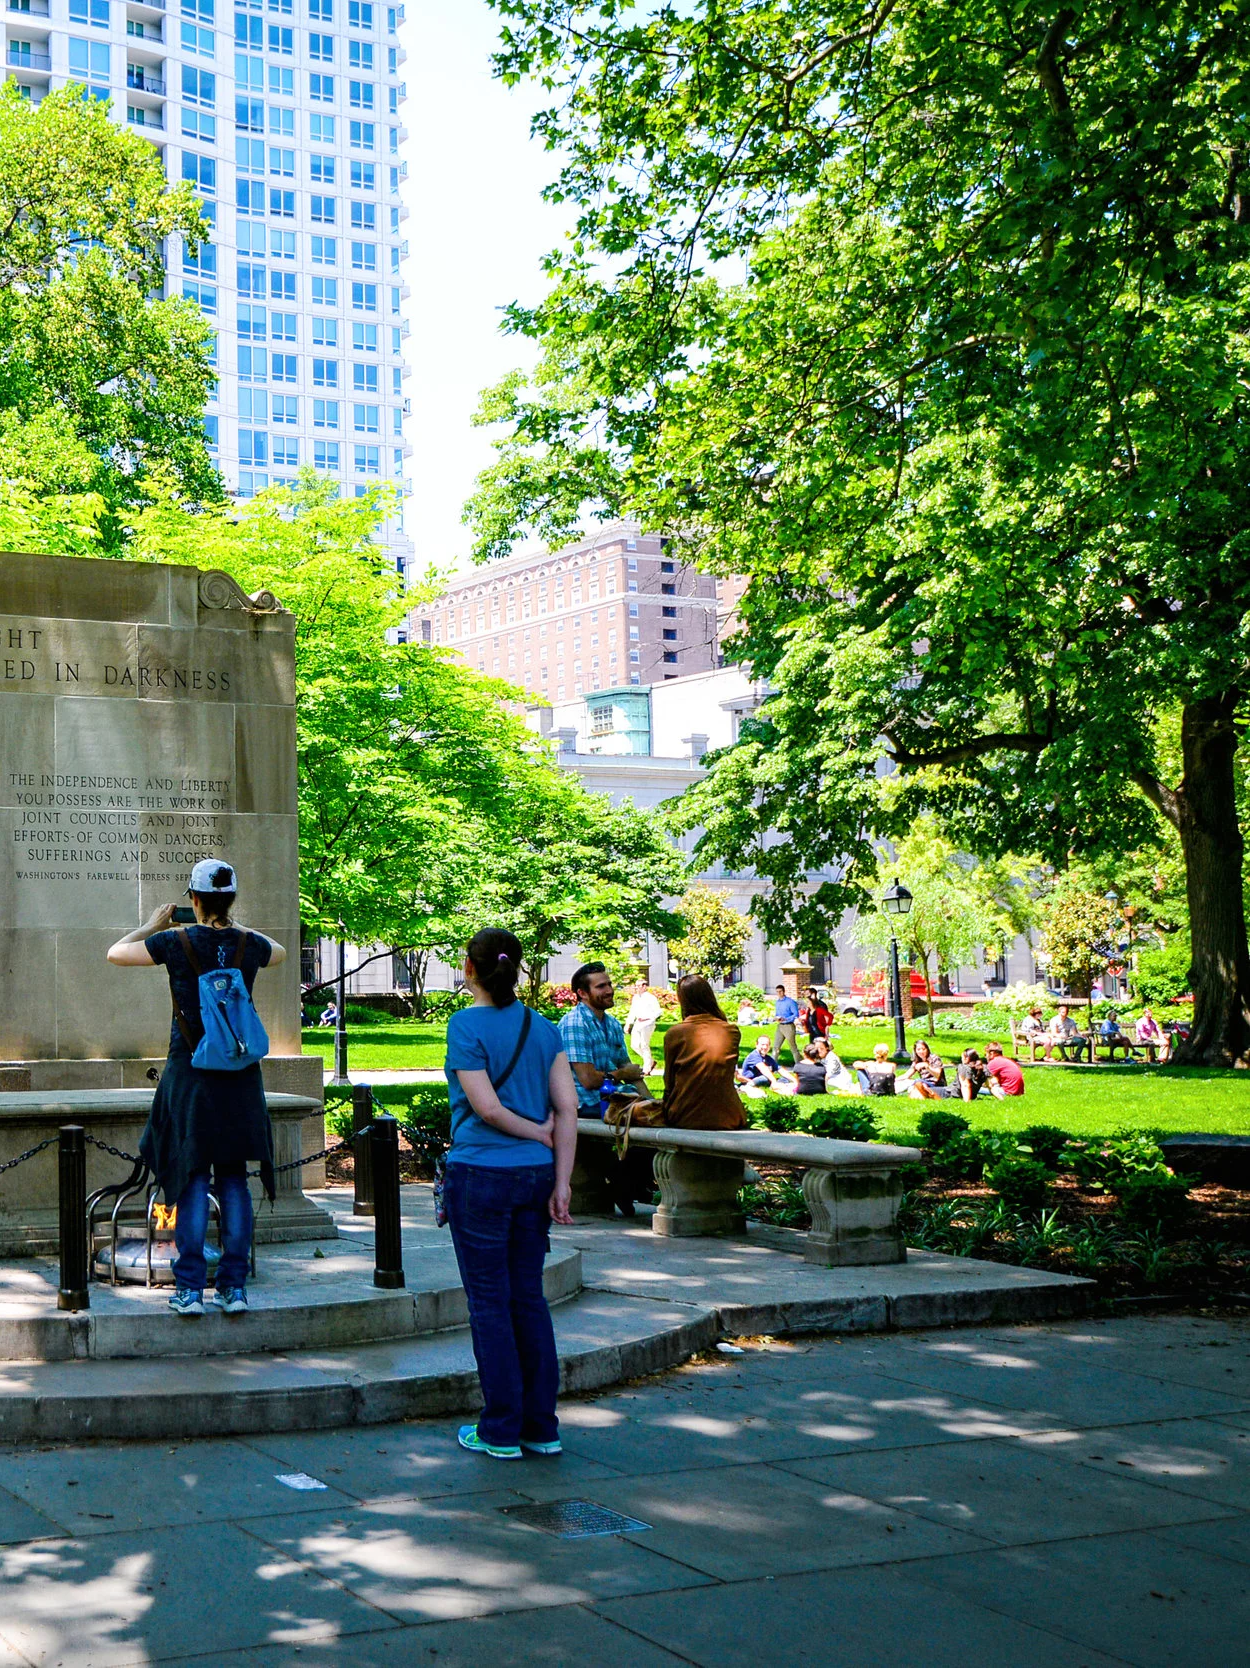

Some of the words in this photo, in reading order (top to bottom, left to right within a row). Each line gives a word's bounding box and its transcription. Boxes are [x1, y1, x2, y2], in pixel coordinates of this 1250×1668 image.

[55, 662, 79, 682] IN
[104, 665, 230, 691] DARKNESS
[10, 774, 35, 786] THE
[41, 774, 138, 789] INDEPENDENCE
[145, 779, 173, 790] AND
[181, 780, 231, 792] LIBERTY
[16, 793, 43, 805] YOU
[48, 794, 102, 806] POSSESS
[107, 796, 132, 807] ARE
[138, 796, 164, 808] THE
[169, 797, 205, 809] WORK
[211, 798, 227, 810] OF
[22, 812, 61, 825] JOINT
[70, 813, 137, 826] COUNCILS
[146, 816, 175, 827] AND
[181, 816, 219, 829] JOINT
[99, 832, 158, 845] COMMON
[165, 834, 226, 847] DANGERS,
[28, 849, 111, 862] SUFFERINGS
[120, 851, 149, 862] AND
[15, 871, 80, 880] WASHINGTON'S
[87, 872, 130, 880] FAREWELL
[135, 872, 170, 881] ADDRESS
